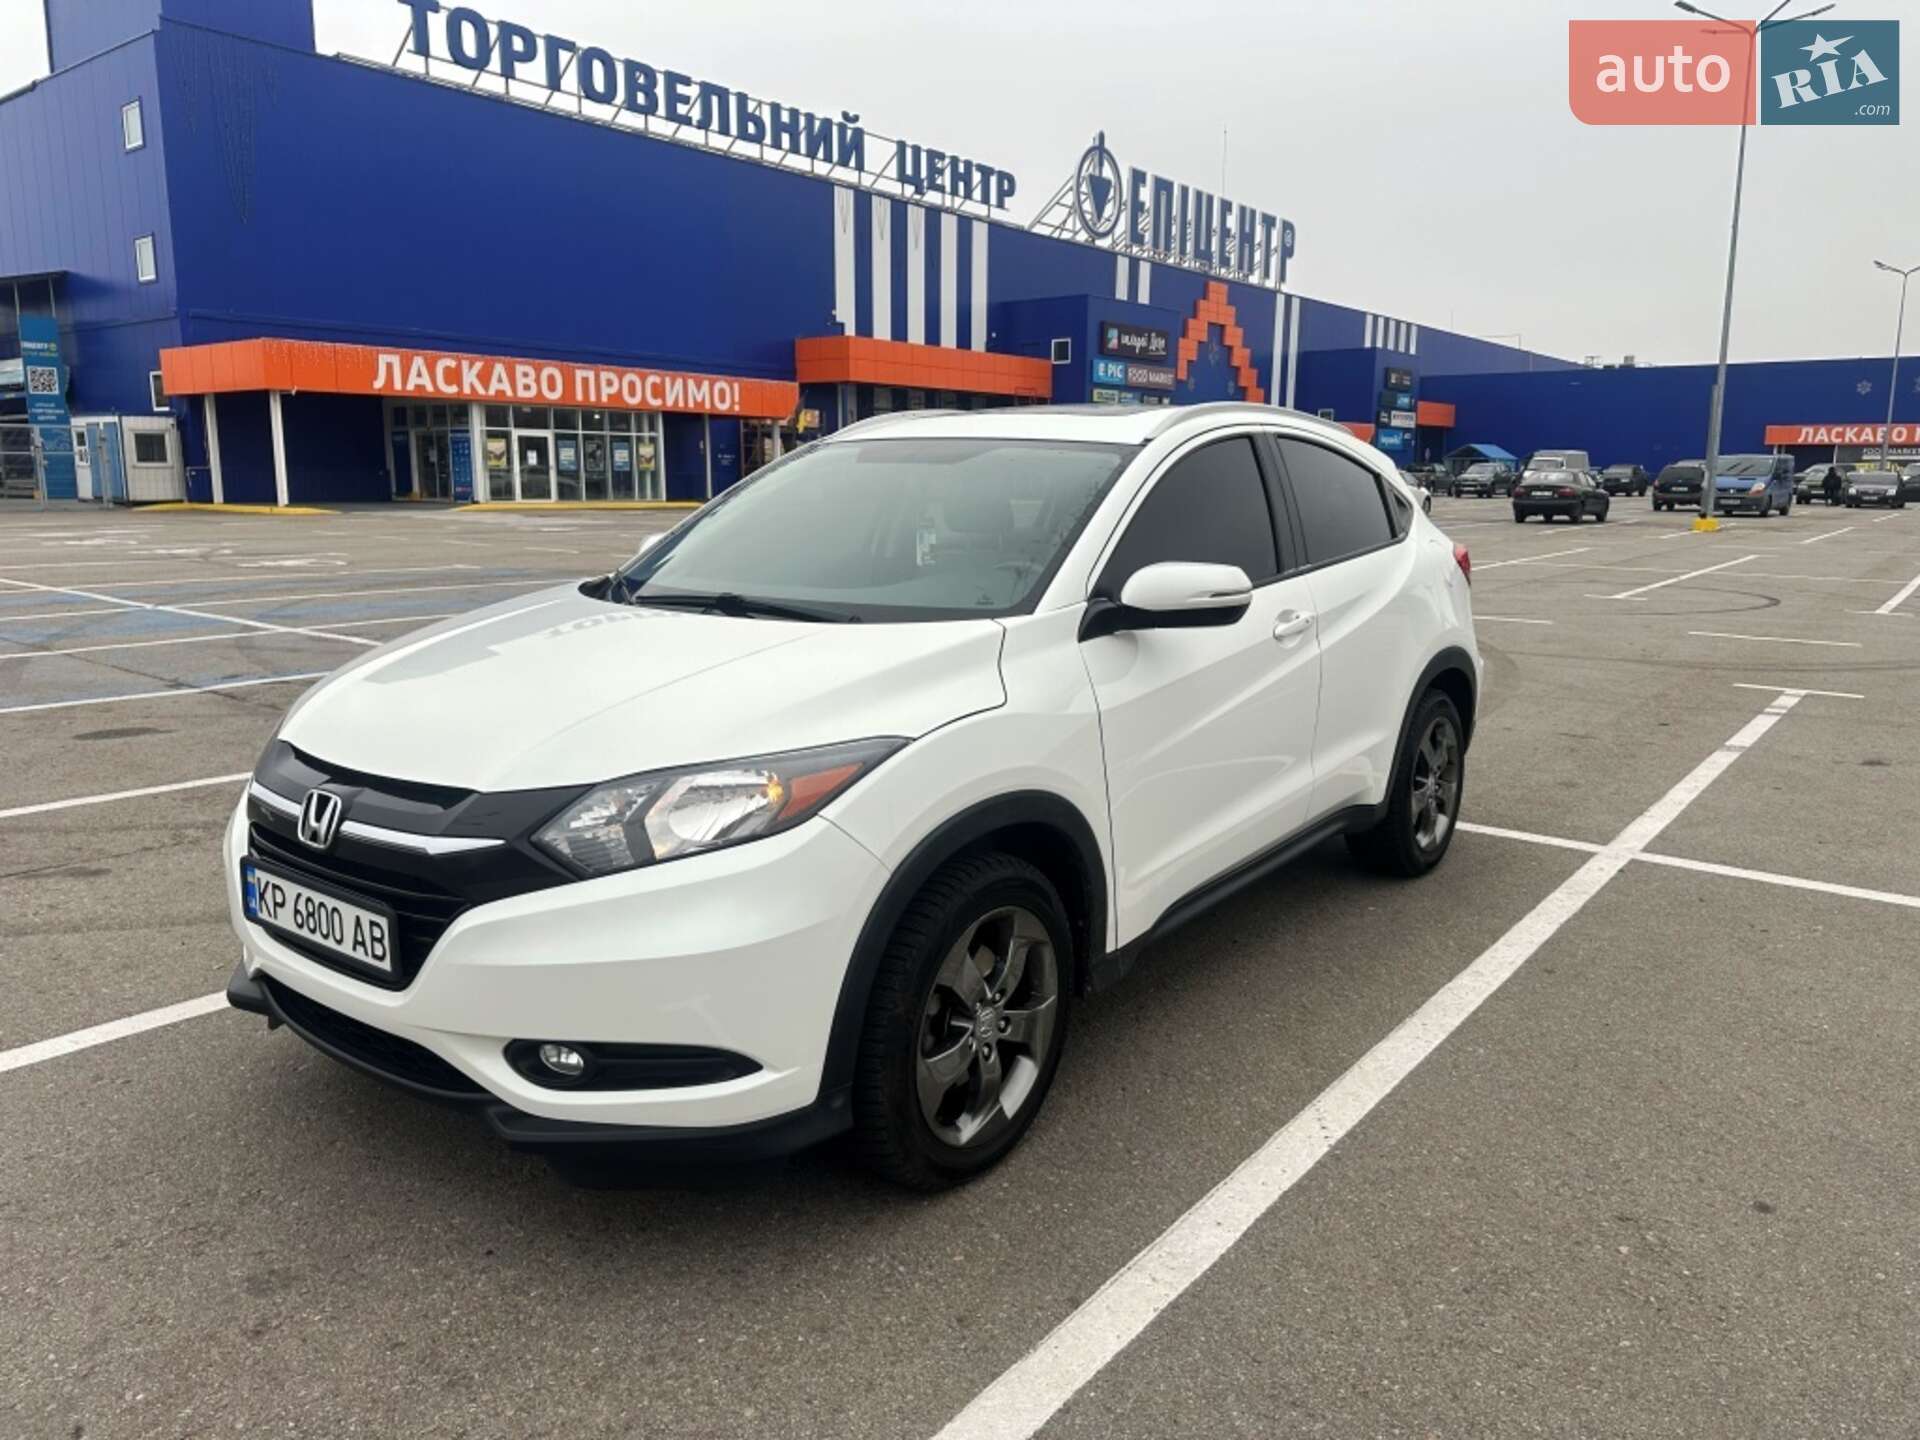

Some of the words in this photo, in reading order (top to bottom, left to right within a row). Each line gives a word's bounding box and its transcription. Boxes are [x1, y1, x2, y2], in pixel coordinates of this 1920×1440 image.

[397, 0, 866, 172] ТОРГОВЕЛЬНИЙ
[896, 139, 1017, 210] ЦЕНТР
[1126, 165, 1296, 283] ЕПІЦЕНТР
[372, 353, 564, 401] ЛАСКАВО
[574, 367, 742, 412] ПРОСИМО!
[256, 877, 286, 919] KP
[293, 892, 344, 945] 6800
[352, 915, 387, 962] AB
